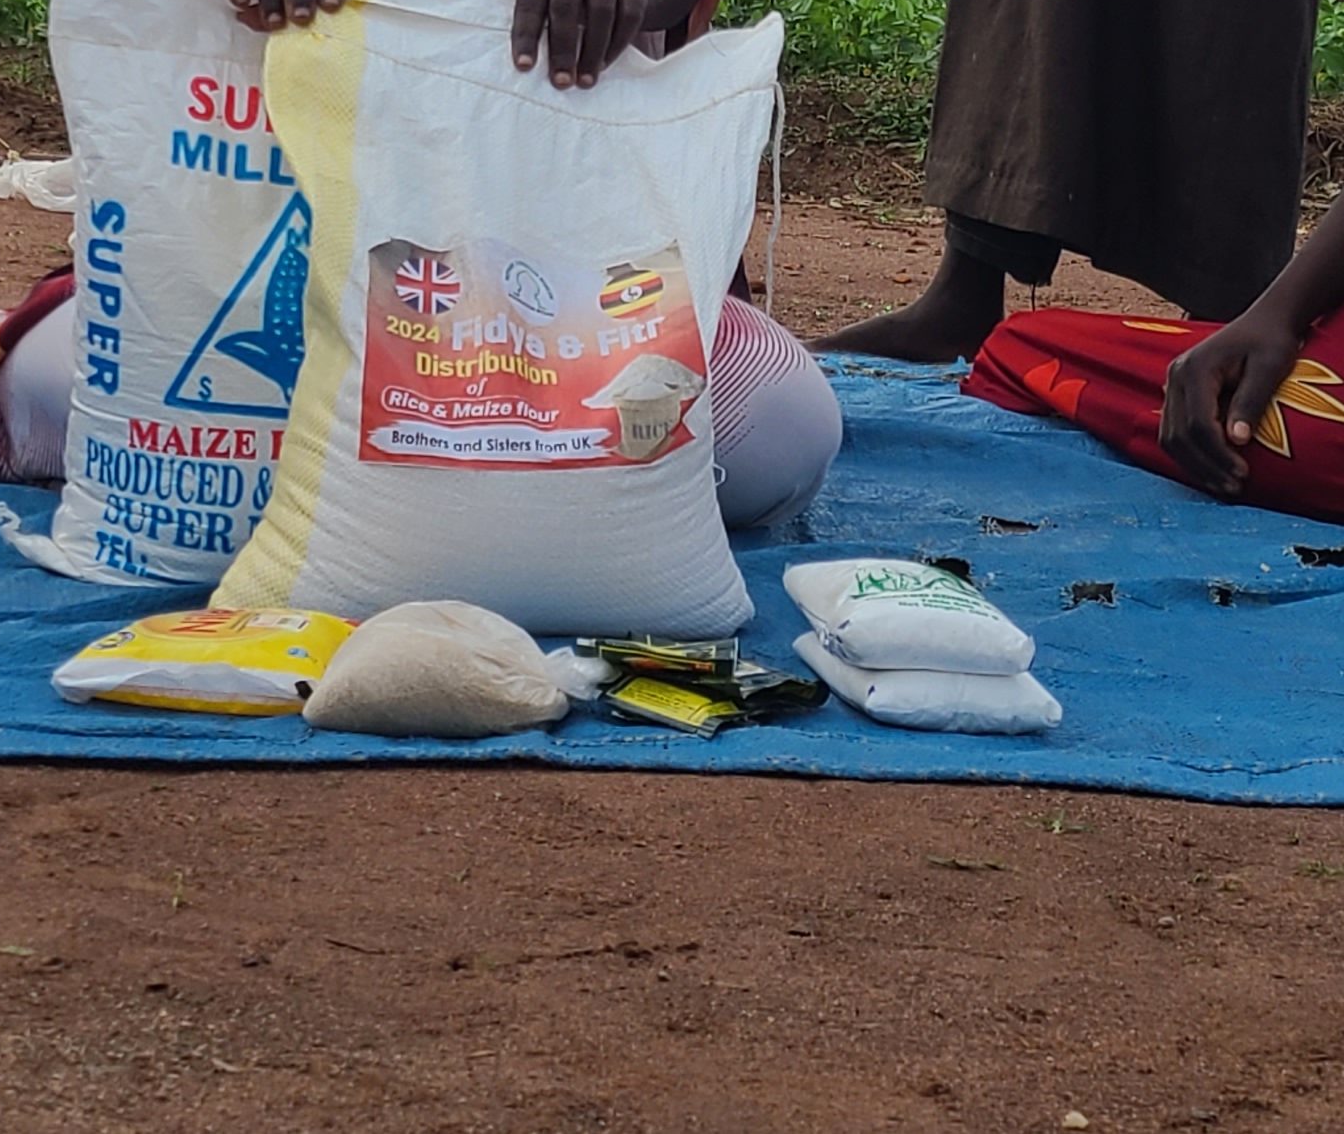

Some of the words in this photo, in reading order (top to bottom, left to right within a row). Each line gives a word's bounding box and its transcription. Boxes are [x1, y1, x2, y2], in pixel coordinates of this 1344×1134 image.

[171, 130, 296, 186] MILL
[87, 198, 126, 396] SUPER
[385, 315, 441, 344] 2024
[451, 312, 546, 360] Fidya
[597, 315, 666, 357] Fitr
[416, 349, 558, 386] Distribution
[466, 377, 488, 397] of
[388, 391, 429, 414] Rice
[431, 405, 448, 418] &
[452, 401, 513, 420] Maize
[516, 400, 560, 423] flour
[128, 418, 257, 460] MAIZE
[391, 430, 449, 450] Brothers
[453, 437, 482, 453] and
[486, 438, 532, 452] Sisters
[535, 436, 568, 453] from
[571, 437, 592, 450] UK
[85, 437, 244, 509] PRODUCED
[252, 467, 273, 511] &
[103, 493, 237, 556] SUPER
